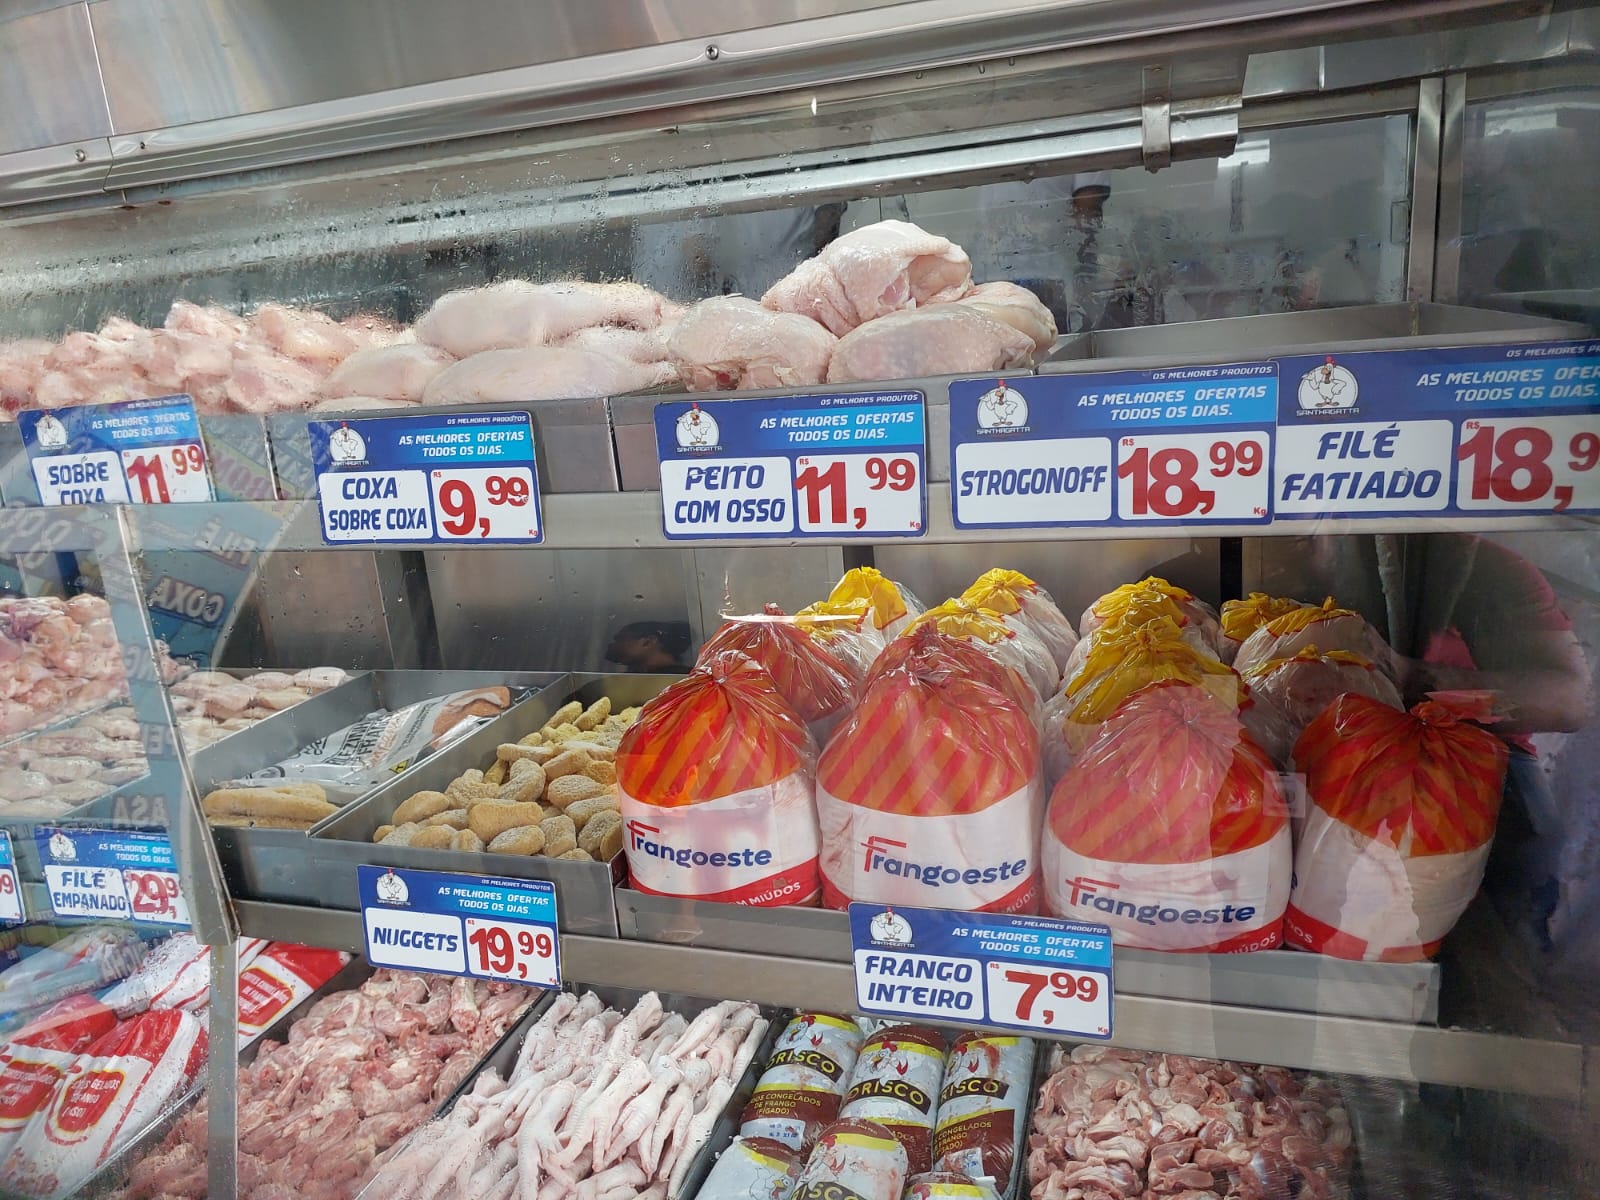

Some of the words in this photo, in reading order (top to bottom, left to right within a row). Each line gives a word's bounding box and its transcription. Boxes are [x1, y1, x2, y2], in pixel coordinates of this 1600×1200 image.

[1506, 349, 1521, 358] OS
[1524, 346, 1585, 356] MELHORES
[1152, 372, 1167, 380] OS
[1168, 369, 1219, 379] MELHORES
[1221, 366, 1273, 377] PRODUTOS
[1416, 373, 1441, 387] AS
[1445, 369, 1543, 386] MELHORES
[833, 397, 875, 405] MELHORES
[876, 394, 918, 403] PRODUTOS
[1077, 394, 1098, 407] AS
[1102, 390, 1185, 405] MELHORES
[1194, 386, 1267, 401] OFERTAS
[1454, 387, 1514, 402] TODOS
[1518, 386, 1545, 399] OS
[1549, 384, 1598, 398] DIAS.
[760, 417, 777, 429] AS
[781, 415, 848, 427] MELHORES
[856, 412, 914, 425] OFERTAS
[1110, 407, 1161, 421] TODOS
[1165, 406, 1187, 419] OS
[1191, 404, 1233, 418] DIAS.
[1296, 407, 1360, 417] SANTHAGATTA
[399, 435, 413, 446] AS
[415, 433, 471, 444] MELHORES
[477, 431, 524, 442] OFERTAS
[788, 430, 829, 442] TODOS
[833, 429, 850, 440] OS
[854, 428, 888, 439] DIAS.
[977, 426, 1030, 435] SANTHAGATTA
[1316, 422, 1400, 460] FILÉ
[423, 446, 458, 457] TODOS
[460, 445, 474, 456] OS
[477, 445, 504, 456] DIAS.
[49, 461, 110, 485] SOBRE
[685, 464, 765, 490] PEITO
[960, 465, 1107, 497] STROGONOFF
[1117, 440, 1263, 517] 18,99
[342, 477, 398, 500] COXA
[794, 457, 916, 529] 11,99
[1281, 469, 1442, 501] FATIADO
[60, 488, 105, 505] COXA
[329, 508, 381, 531] SOBRE
[386, 507, 428, 530] COXA
[674, 499, 719, 524] COM
[726, 498, 785, 522] OSSO
[627, 820, 772, 867] Frangoeste
[861, 835, 1027, 887] Frangoeste
[53, 892, 126, 911] EMPANADO
[438, 887, 450, 896] AS
[453, 888, 502, 901] MELHORES
[507, 894, 549, 906] OFERTAS
[749, 882, 801, 905] MIÚDOS
[1066, 877, 1255, 926] Frangoeste
[459, 900, 488, 910] TODOS
[491, 903, 504, 912] OS
[1024, 921, 1065, 930] MELHORES
[1066, 925, 1109, 934] PRODUTOS
[952, 927, 968, 938] AS
[972, 929, 1039, 943] MELHORES
[1045, 936, 1104, 950] OFERTAS
[979, 941, 1019, 953] TODOS
[1023, 945, 1041, 955] OS
[1044, 947, 1078, 960] DIAS.
[865, 955, 973, 983] FRANGO
[867, 982, 973, 1010] INTEIRO
[1004, 970, 1099, 1025] 7,99
